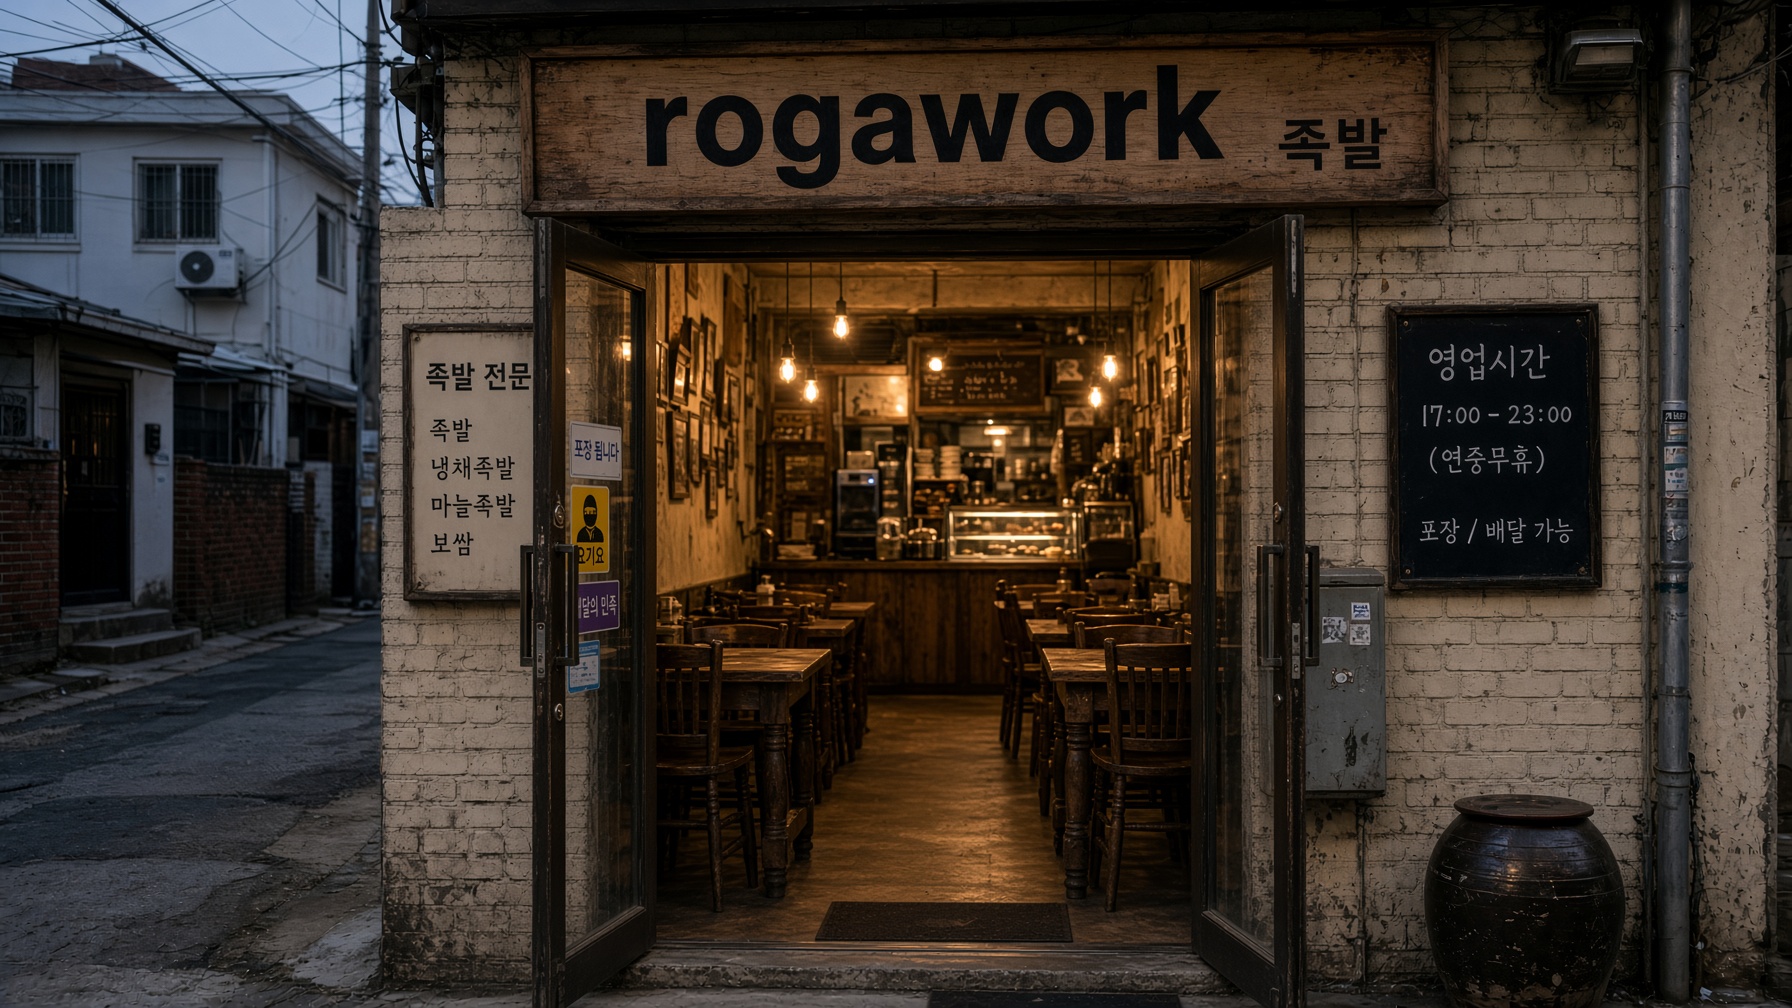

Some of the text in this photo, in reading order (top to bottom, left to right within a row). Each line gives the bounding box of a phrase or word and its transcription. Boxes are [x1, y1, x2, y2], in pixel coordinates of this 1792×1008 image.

[645, 64, 1225, 189] rogawork
[1279, 117, 1389, 172] 족발
[1429, 344, 1550, 382] 영업시간
[426, 362, 531, 391] 족발 전문
[1422, 405, 1480, 427] 17:00
[1508, 405, 1572, 425] 23:00
[430, 418, 472, 442] 족발
[574, 439, 619, 462] 포장 됩니다
[1429, 445, 1545, 475] (연중무휴)
[432, 456, 515, 480] 냉채족발
[431, 494, 515, 518] 마늘족발
[1419, 518, 1573, 544] 포장 / 배달 가능
[431, 532, 474, 556] 보쌈
[601, 594, 617, 616] 민족
